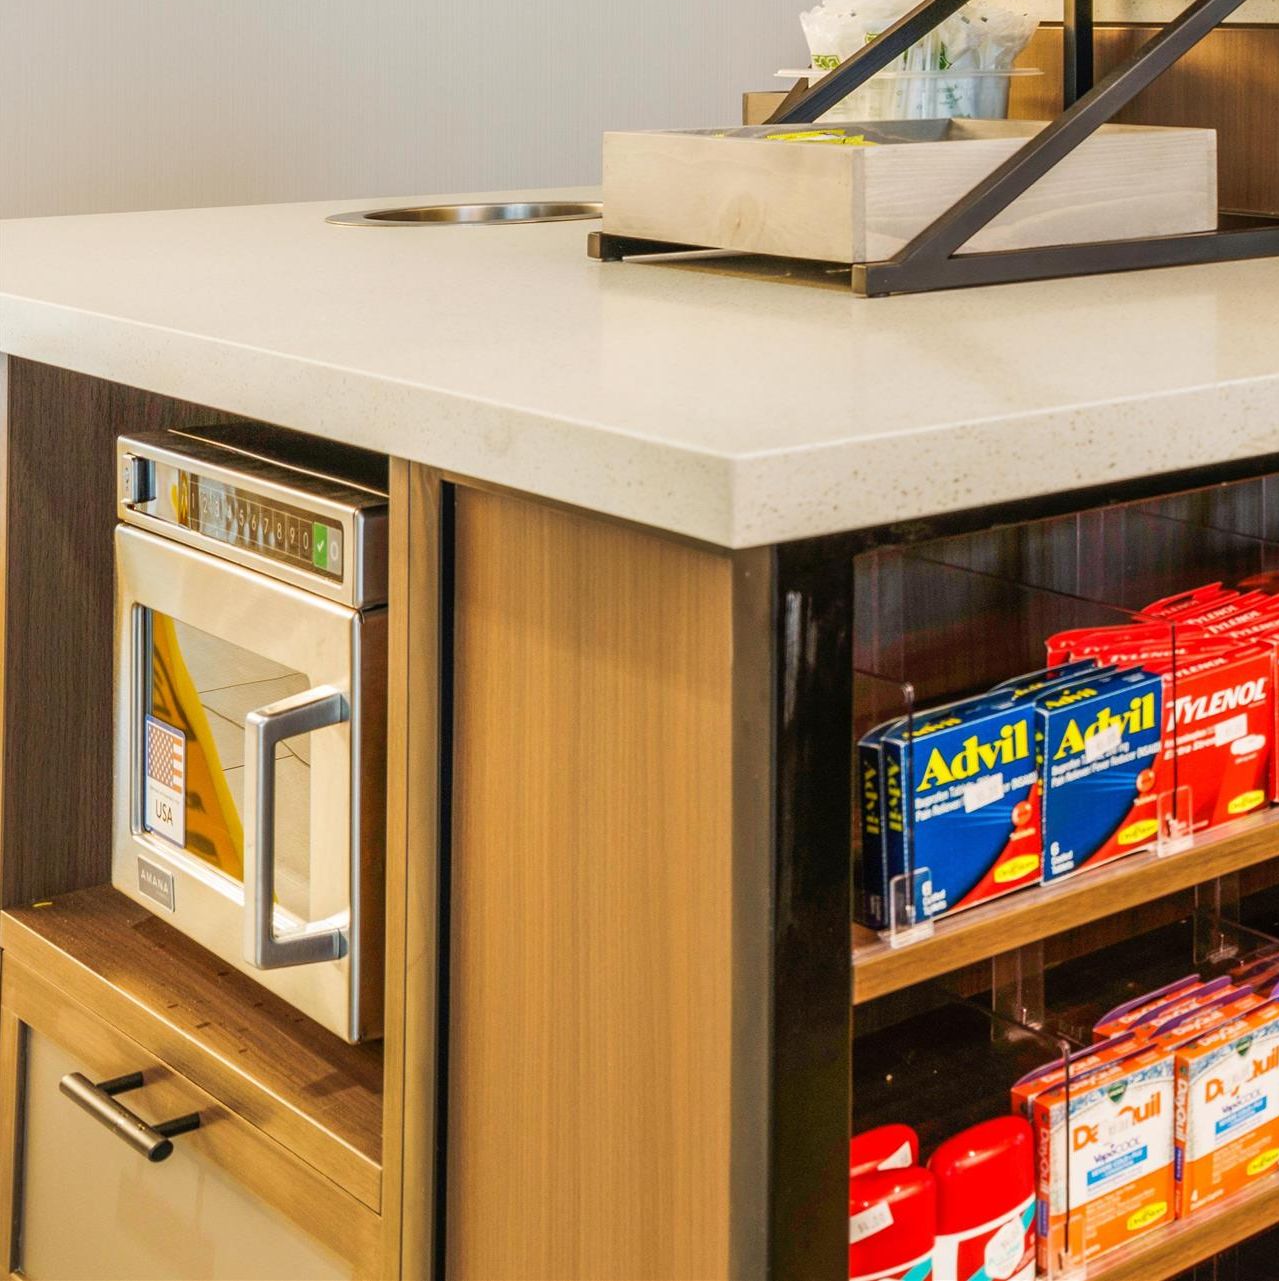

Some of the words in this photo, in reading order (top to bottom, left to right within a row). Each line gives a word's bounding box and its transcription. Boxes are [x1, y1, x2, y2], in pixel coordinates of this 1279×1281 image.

[238, 510, 245, 527] 5
[250, 514, 257, 531] 6
[263, 517, 270, 534] 7
[276, 523, 283, 541] 8
[289, 526, 296, 544] 9
[302, 531, 309, 550] 0
[1209, 610, 1261, 634] TYLENOL
[1053, 693, 1156, 762] Advil
[1166, 676, 1269, 734] TYLENOL
[916, 720, 1029, 792] Advil
[155, 799, 174, 826] USA
[140, 869, 169, 895] AMANA
[1176, 1078, 1188, 1142] DayQuil
[1039, 1127, 1051, 1195] DayQuil
